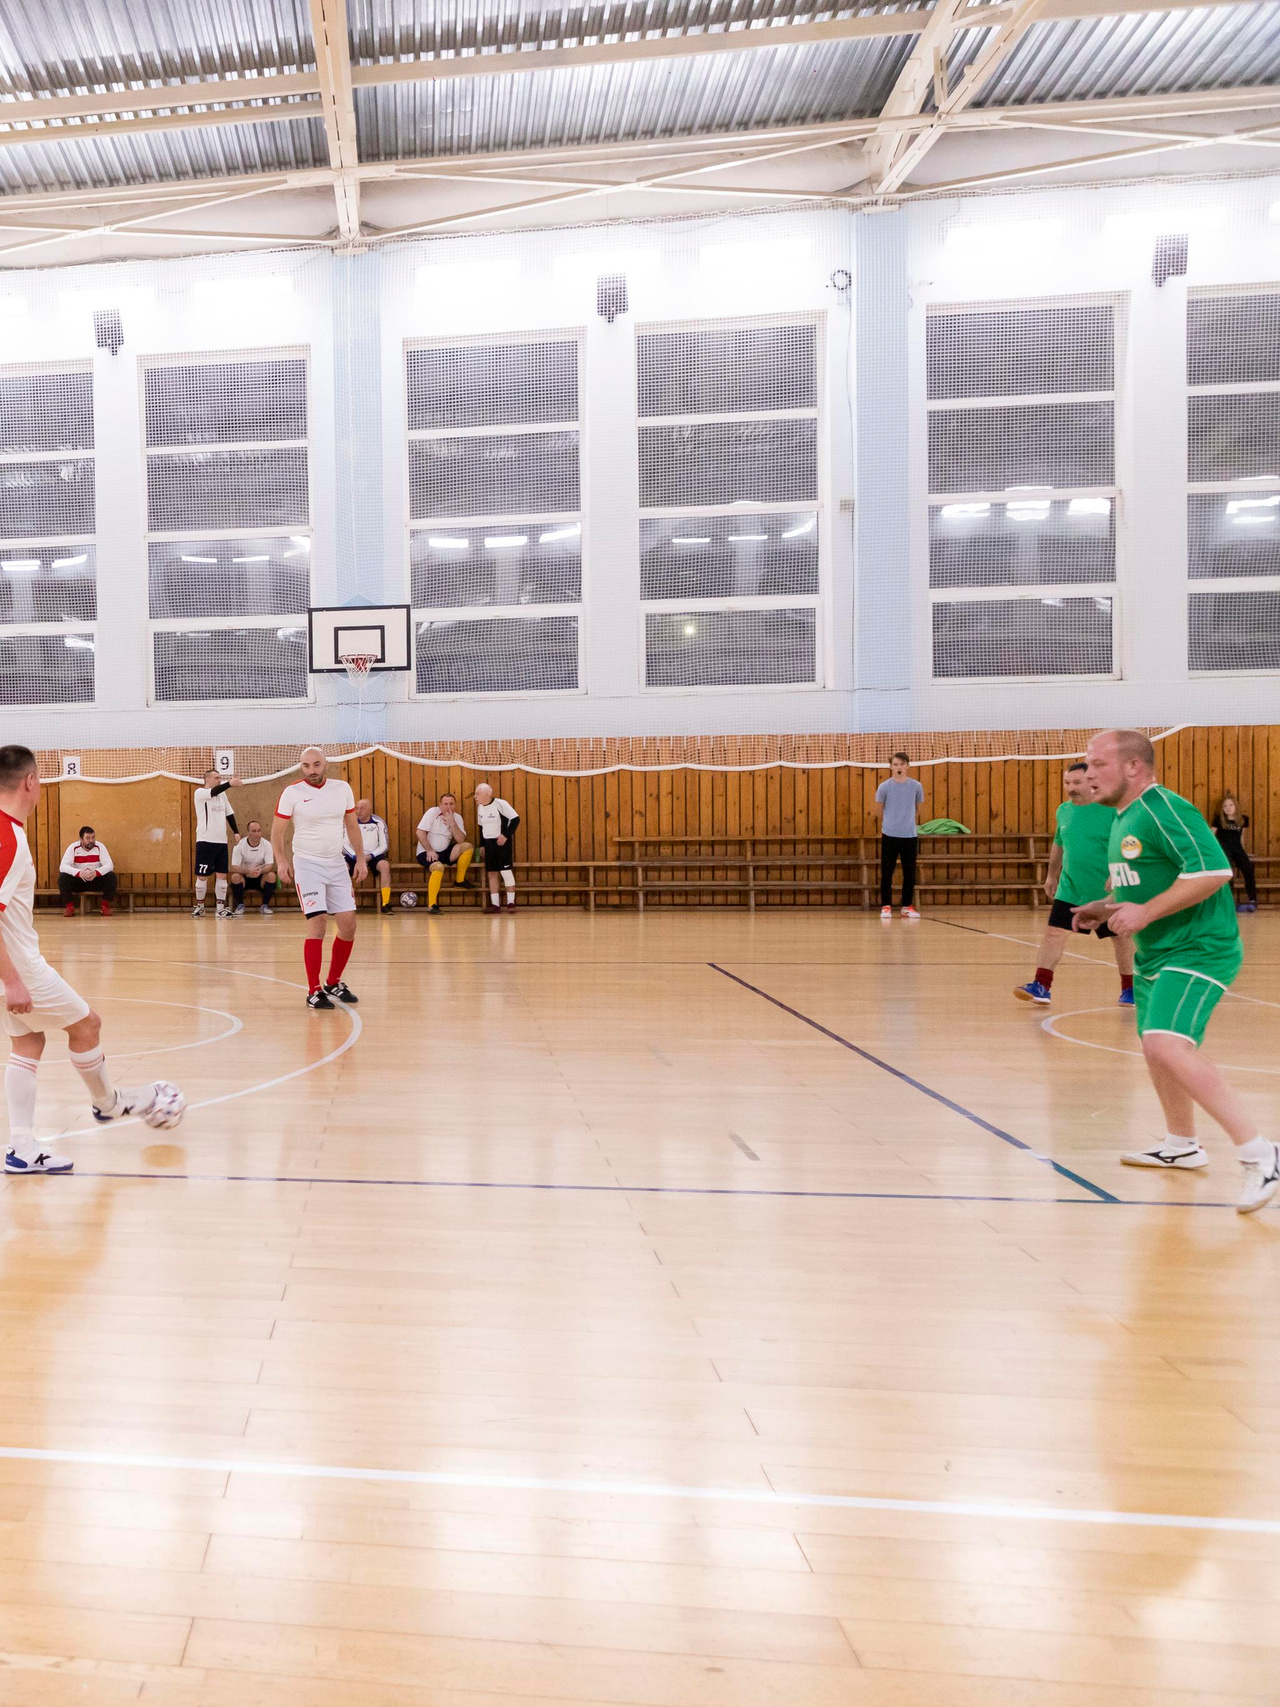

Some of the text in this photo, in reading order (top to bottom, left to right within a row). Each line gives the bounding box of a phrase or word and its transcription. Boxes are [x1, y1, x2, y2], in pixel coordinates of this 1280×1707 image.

[67, 762, 77, 775] 8
[219, 756, 229, 771] 9
[199, 863, 208, 874] 77
